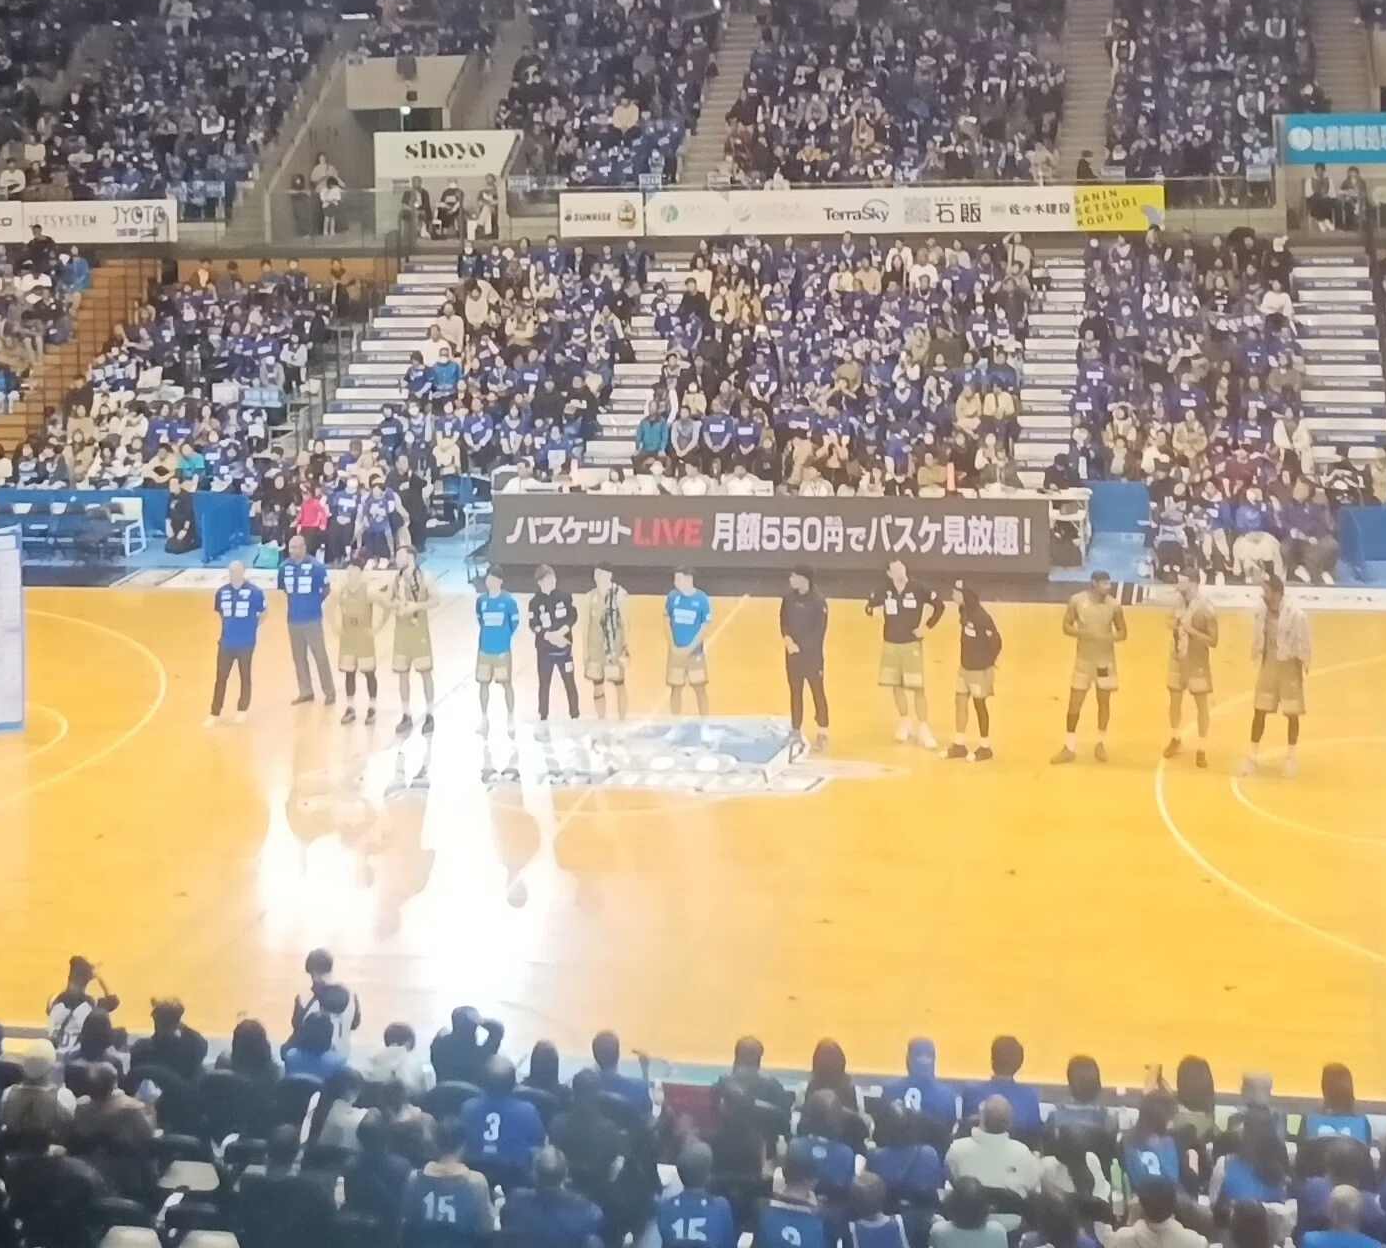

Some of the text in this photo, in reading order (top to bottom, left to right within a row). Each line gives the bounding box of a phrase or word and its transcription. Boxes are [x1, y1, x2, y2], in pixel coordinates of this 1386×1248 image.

[405, 140, 485, 160] shoyo
[574, 211, 612, 222] SUNRISE
[823, 206, 890, 223] TerraSky
[483, 1112, 501, 1143] 3
[422, 1190, 457, 1224] 15
[670, 1216, 707, 1243] 15
